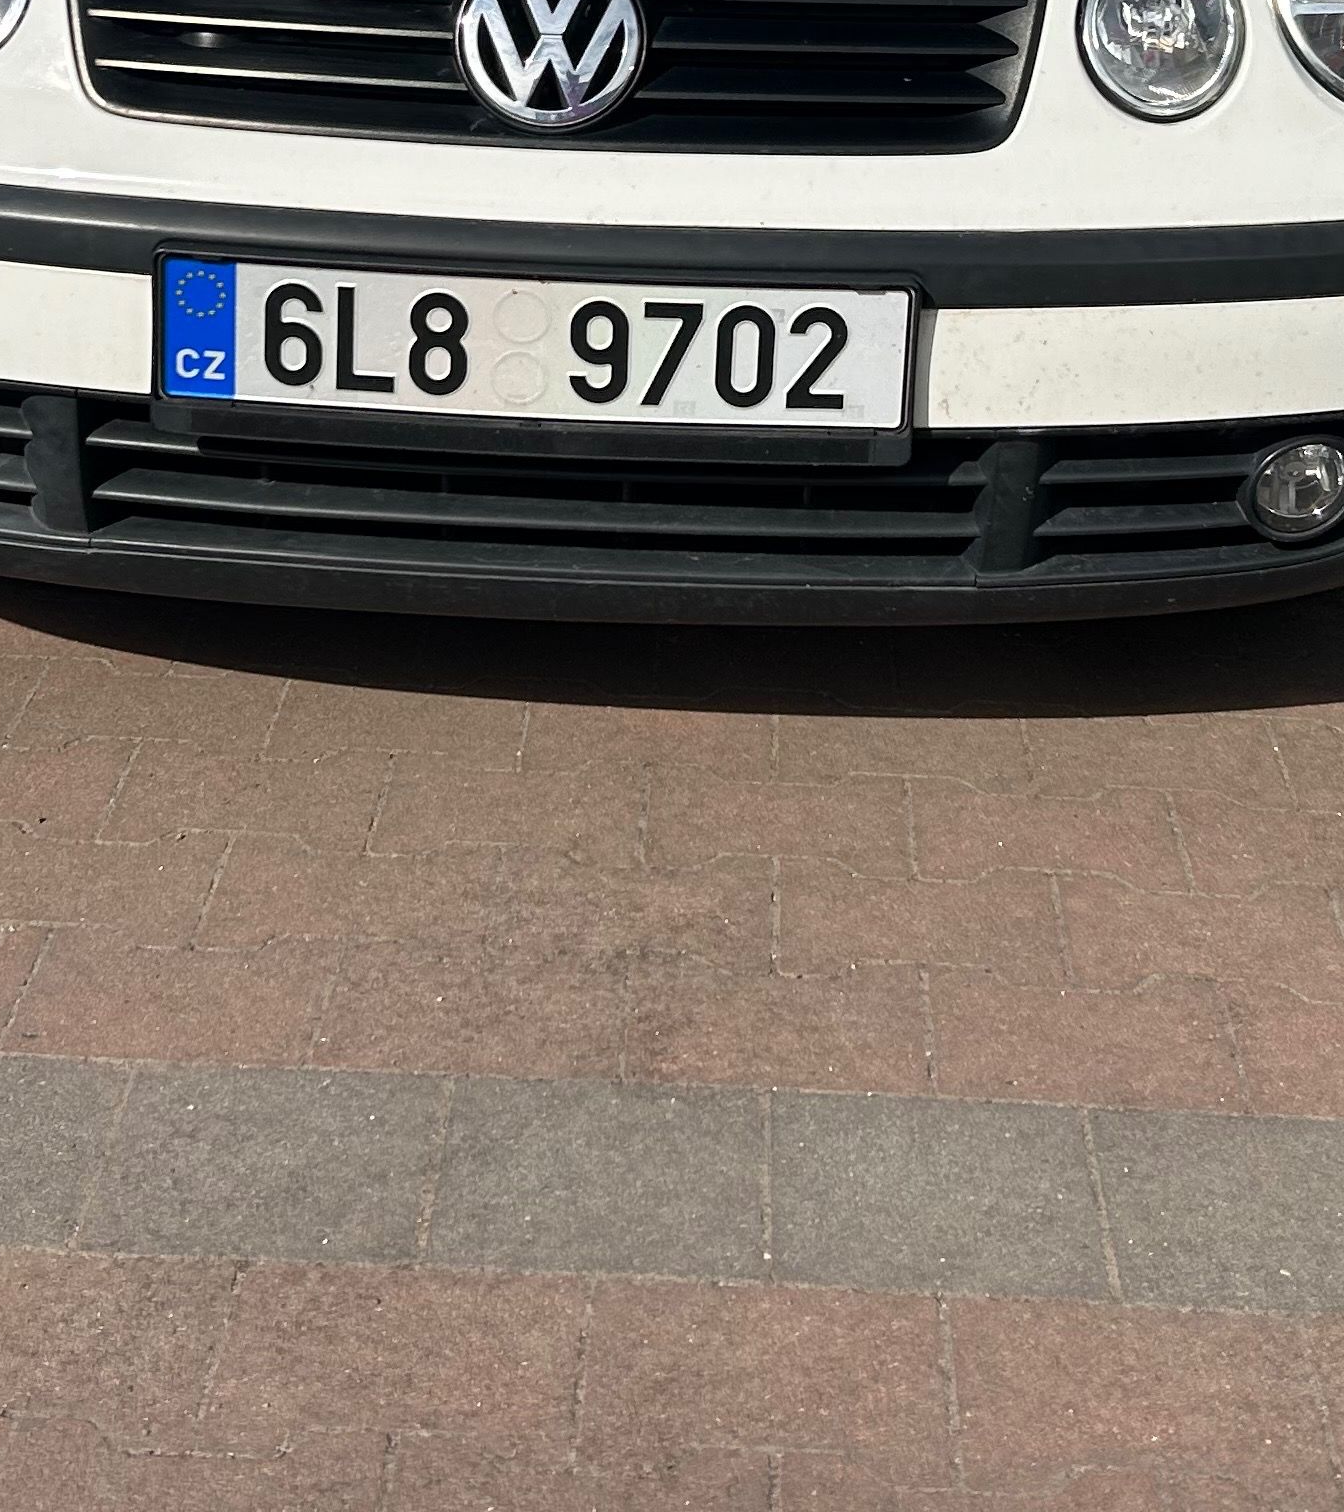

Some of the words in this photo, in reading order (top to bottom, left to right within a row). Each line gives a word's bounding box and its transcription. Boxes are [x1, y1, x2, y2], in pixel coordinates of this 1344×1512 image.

[175, 348, 227, 381] CZ
[263, 282, 470, 396] 6L8
[568, 300, 850, 409] 9702
